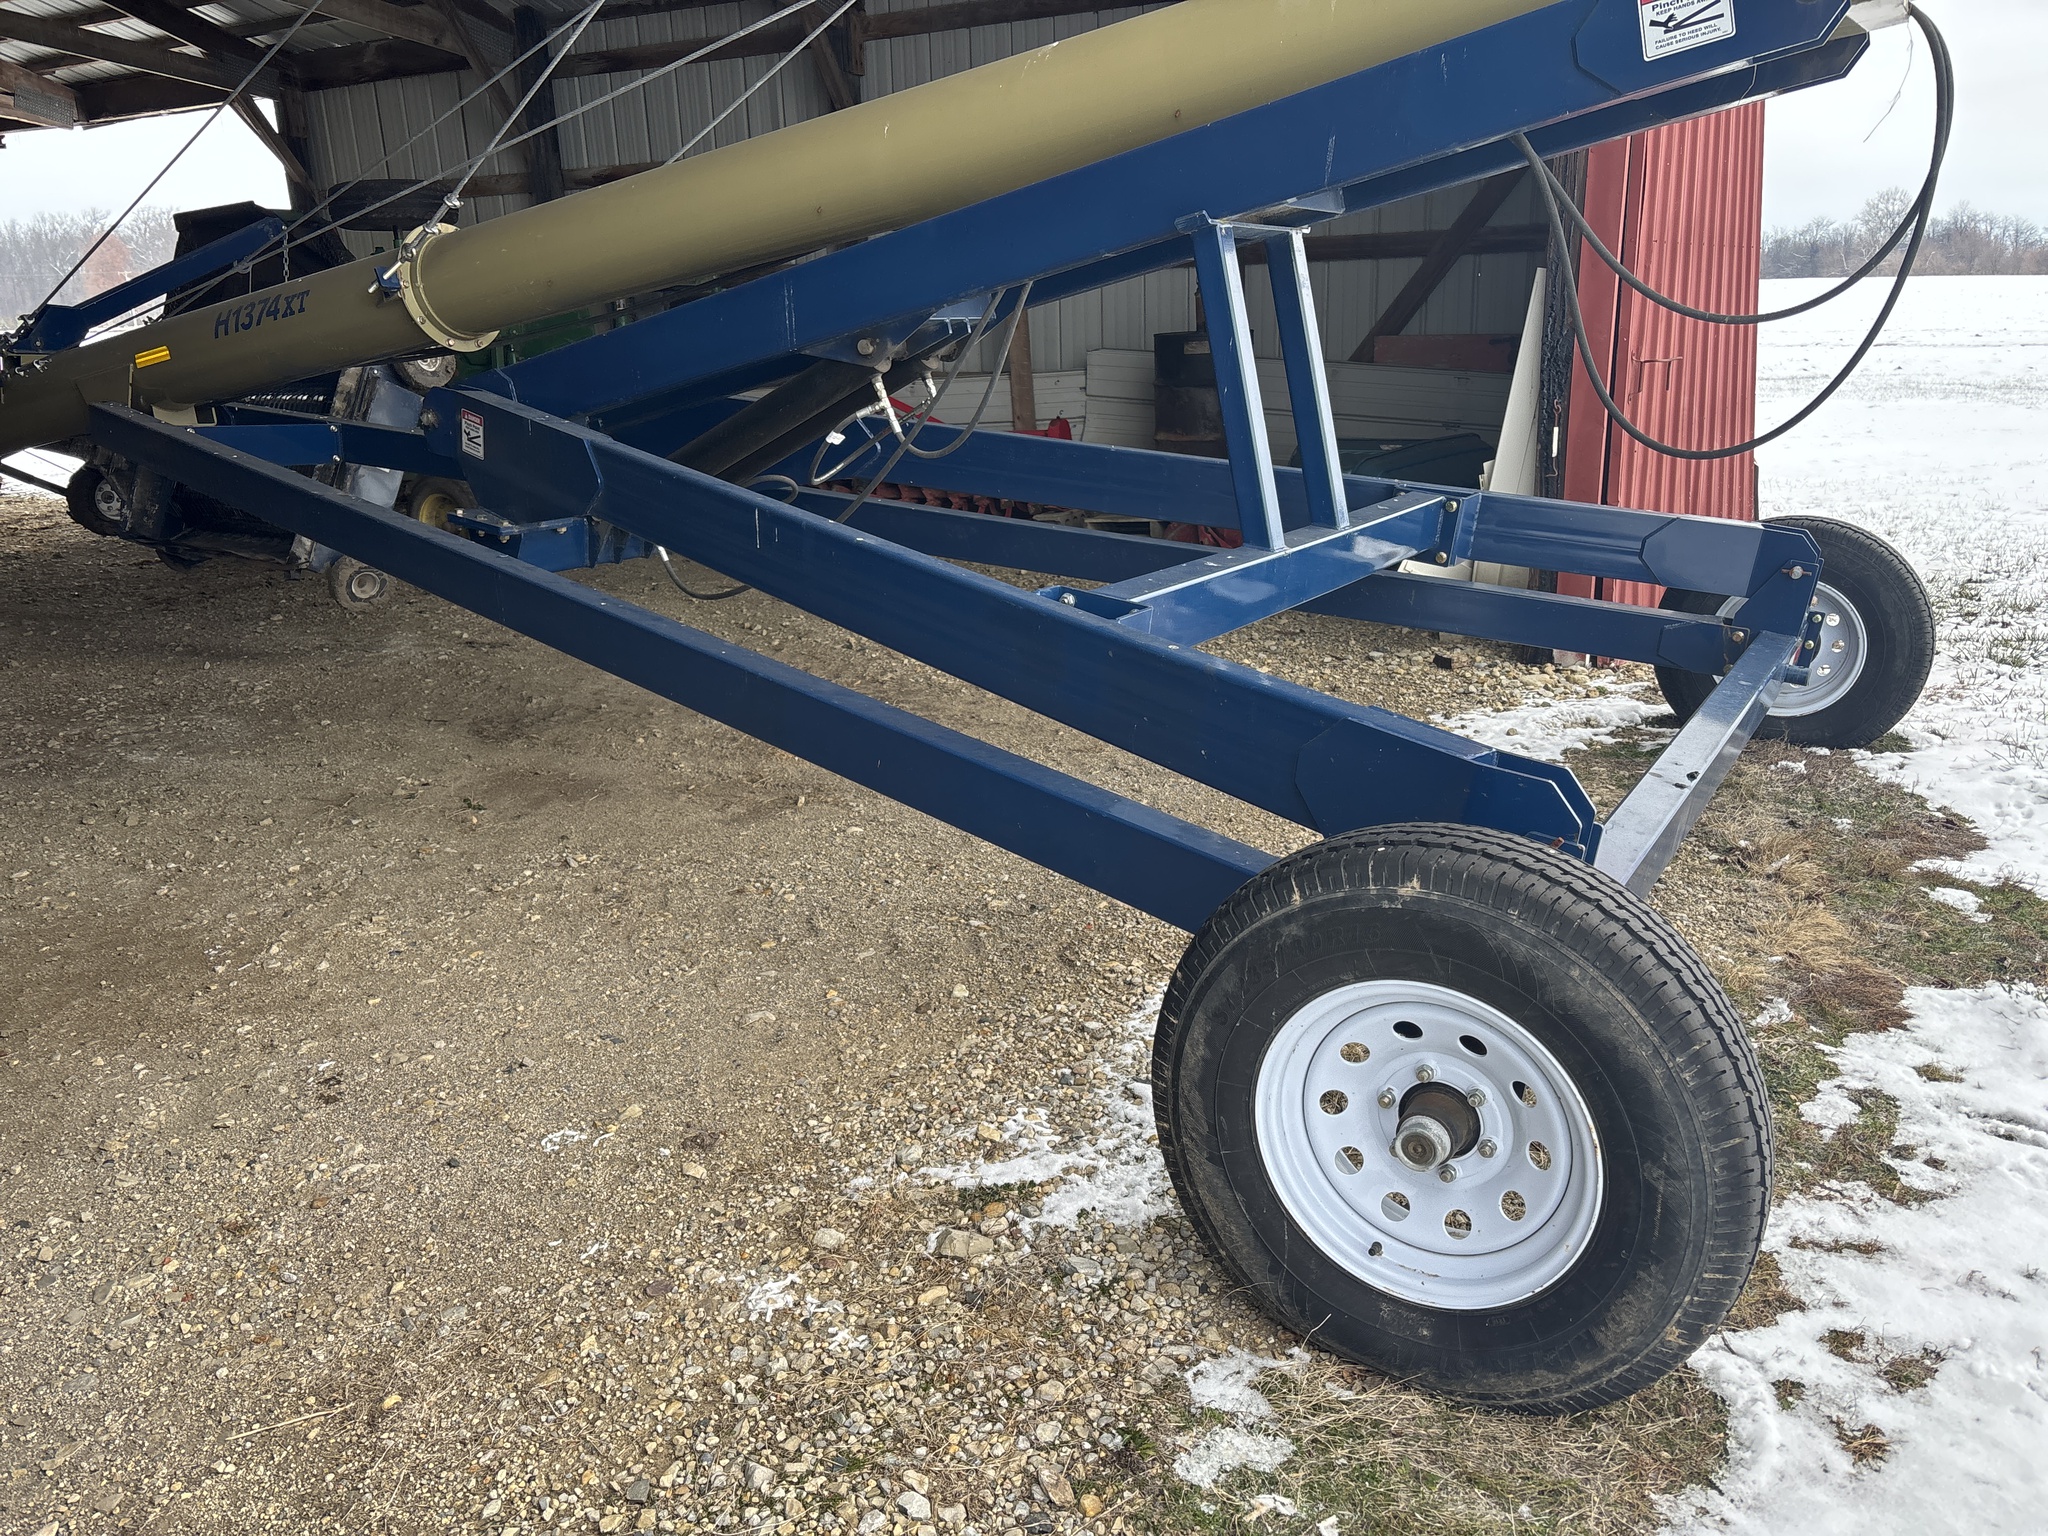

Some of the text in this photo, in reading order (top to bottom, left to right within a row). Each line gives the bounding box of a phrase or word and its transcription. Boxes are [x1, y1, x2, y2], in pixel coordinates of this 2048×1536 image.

[1656, 7, 1672, 16] KEEP
[1673, 1, 1695, 11] HANDS
[1655, 34, 1677, 45] FAILURE
[1687, 27, 1703, 35] HEED
[1704, 23, 1718, 31] WILL
[1655, 40, 1674, 50] CAUSE
[1675, 33, 1700, 44] SERIOUS
[214, 289, 311, 339] H1374XT
